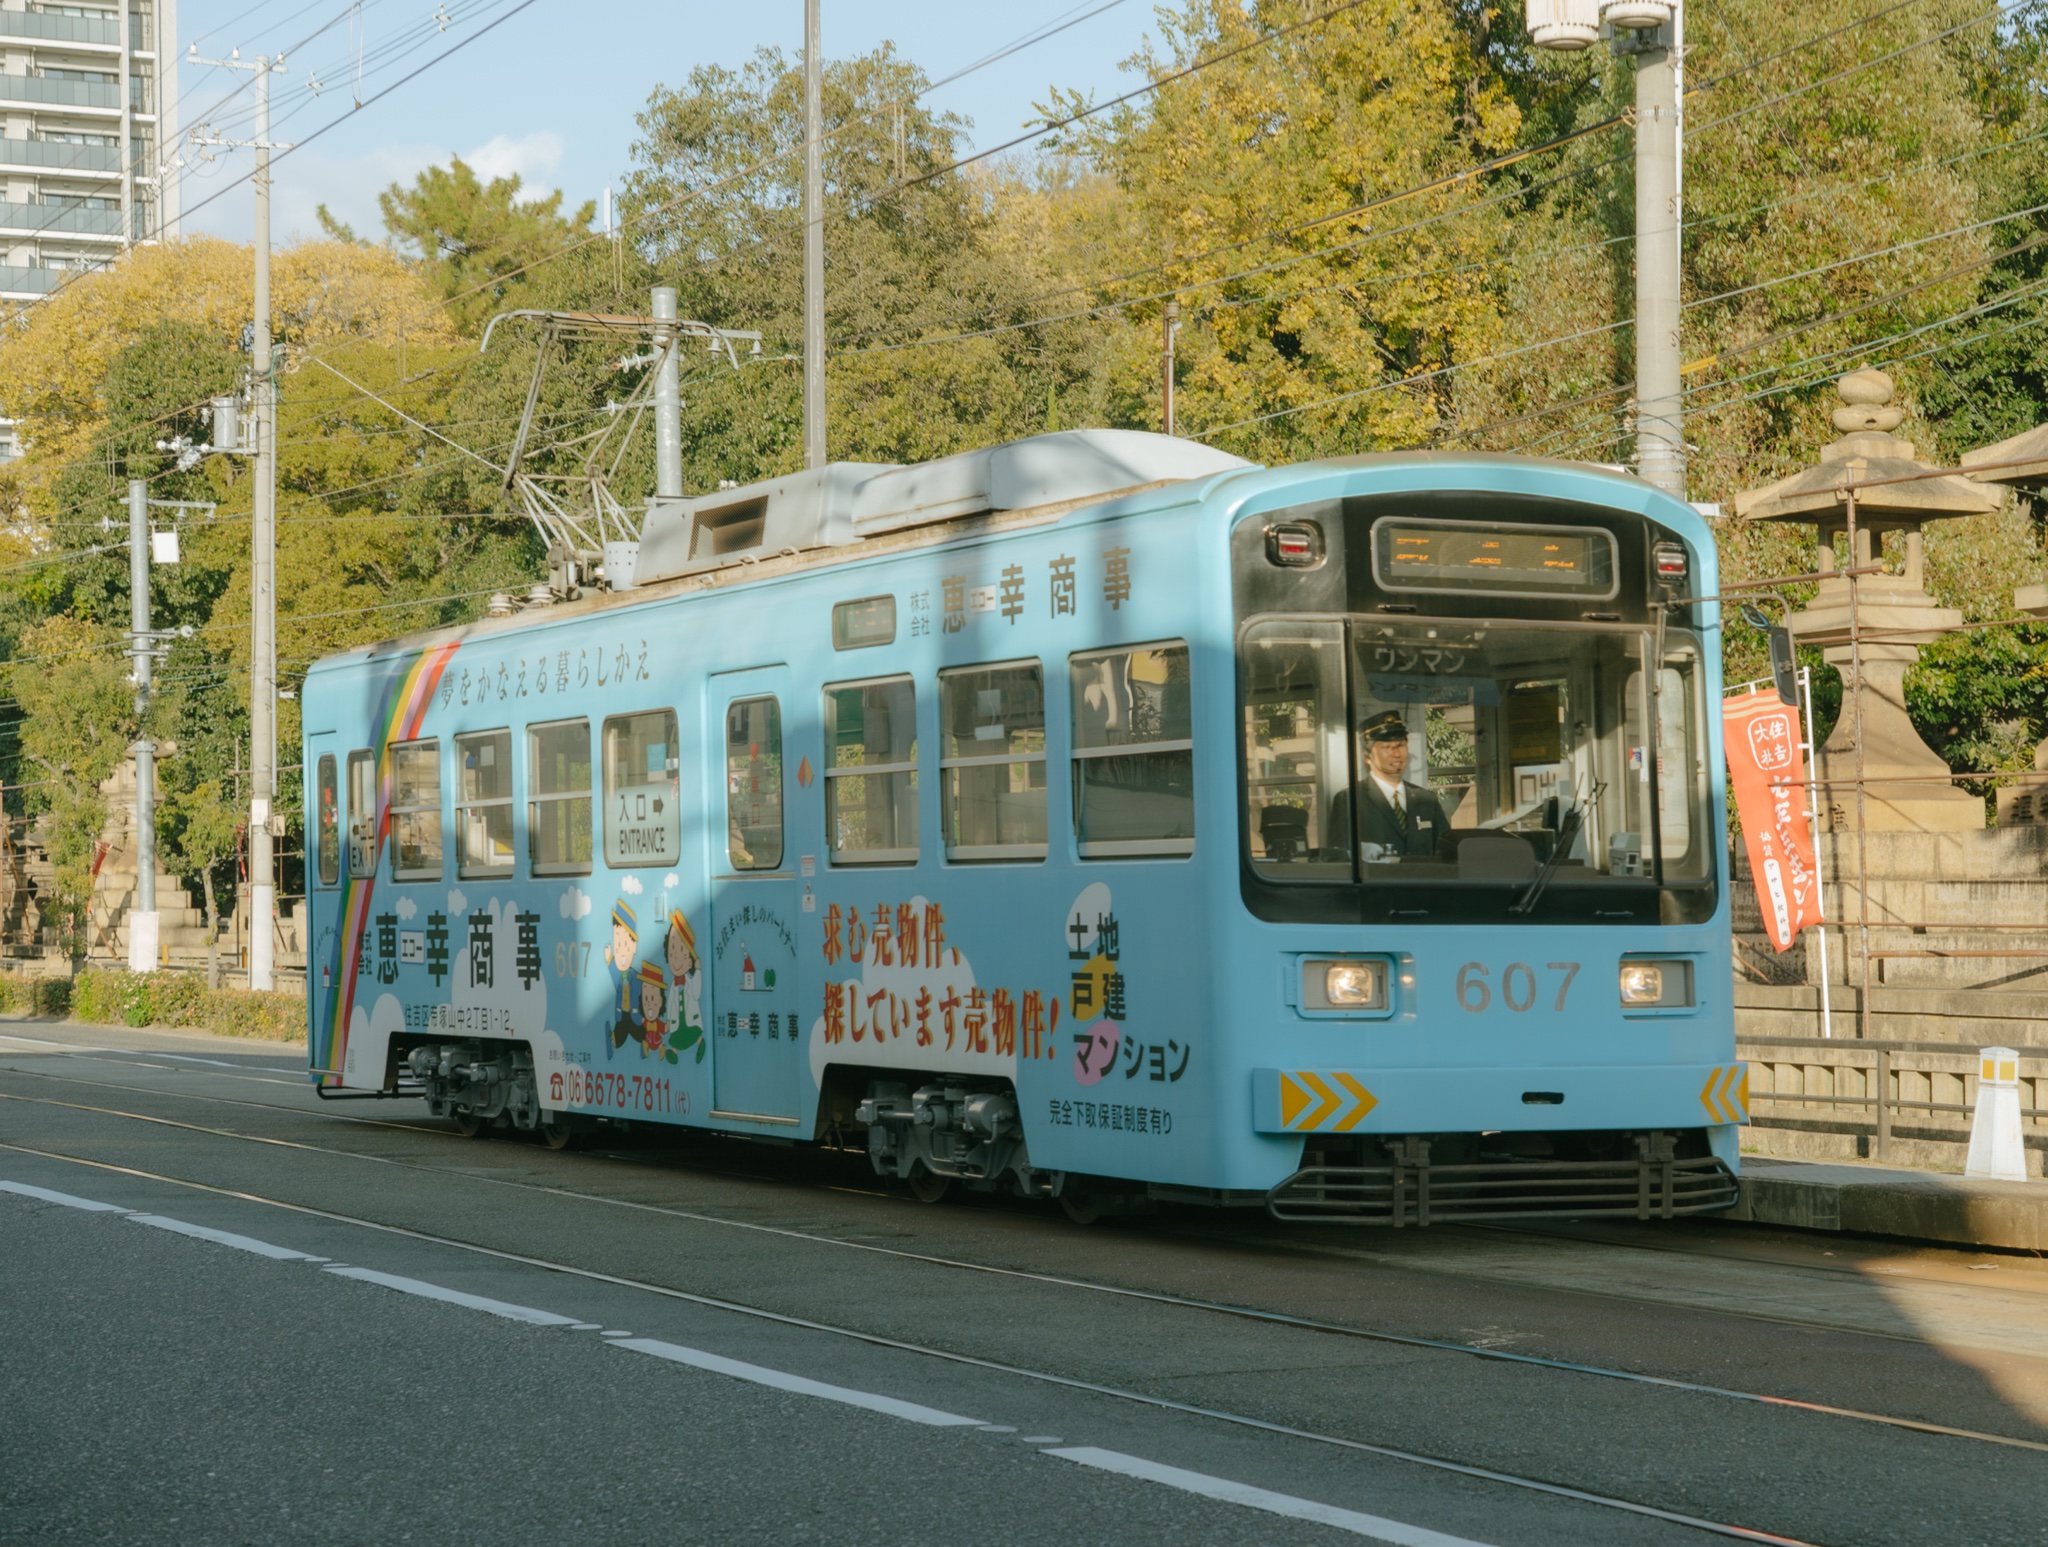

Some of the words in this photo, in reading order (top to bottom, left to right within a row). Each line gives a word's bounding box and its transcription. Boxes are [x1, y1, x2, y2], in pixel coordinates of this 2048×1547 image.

[441, 639, 650, 710] 夢をかなえる暮らしかえ
[1375, 648, 1465, 672] ワンマン
[619, 794, 645, 822] 入口
[352, 846, 375, 868] EXIT
[619, 827, 665, 854] ENTRANCE
[1068, 912, 1120, 961] 土地
[555, 941, 592, 978] 607
[1071, 971, 1127, 1021] 戸建
[1455, 961, 1581, 1013] 607
[1073, 1032, 1190, 1083] マンション
[1049, 1099, 1172, 1135] 完全下取保証制度有り
